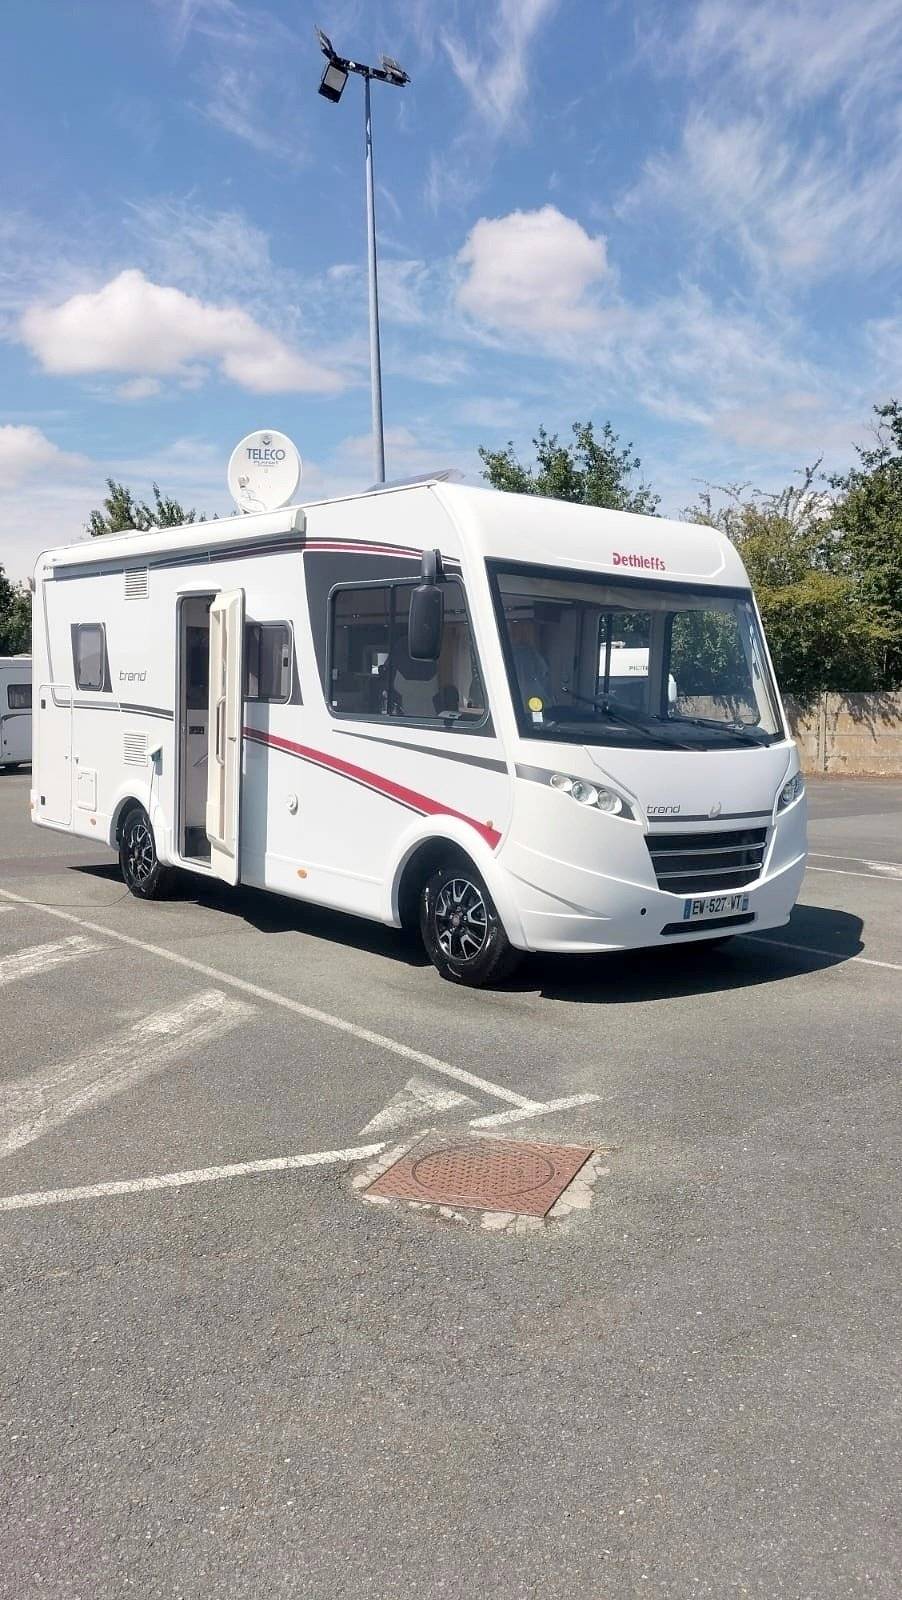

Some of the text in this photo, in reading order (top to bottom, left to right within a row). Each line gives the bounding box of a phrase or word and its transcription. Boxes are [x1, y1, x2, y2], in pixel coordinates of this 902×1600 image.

[246, 448, 286, 461] TELECO
[612, 552, 666, 571] Dethleffs
[119, 669, 147, 681] trend
[646, 804, 681, 814] trend
